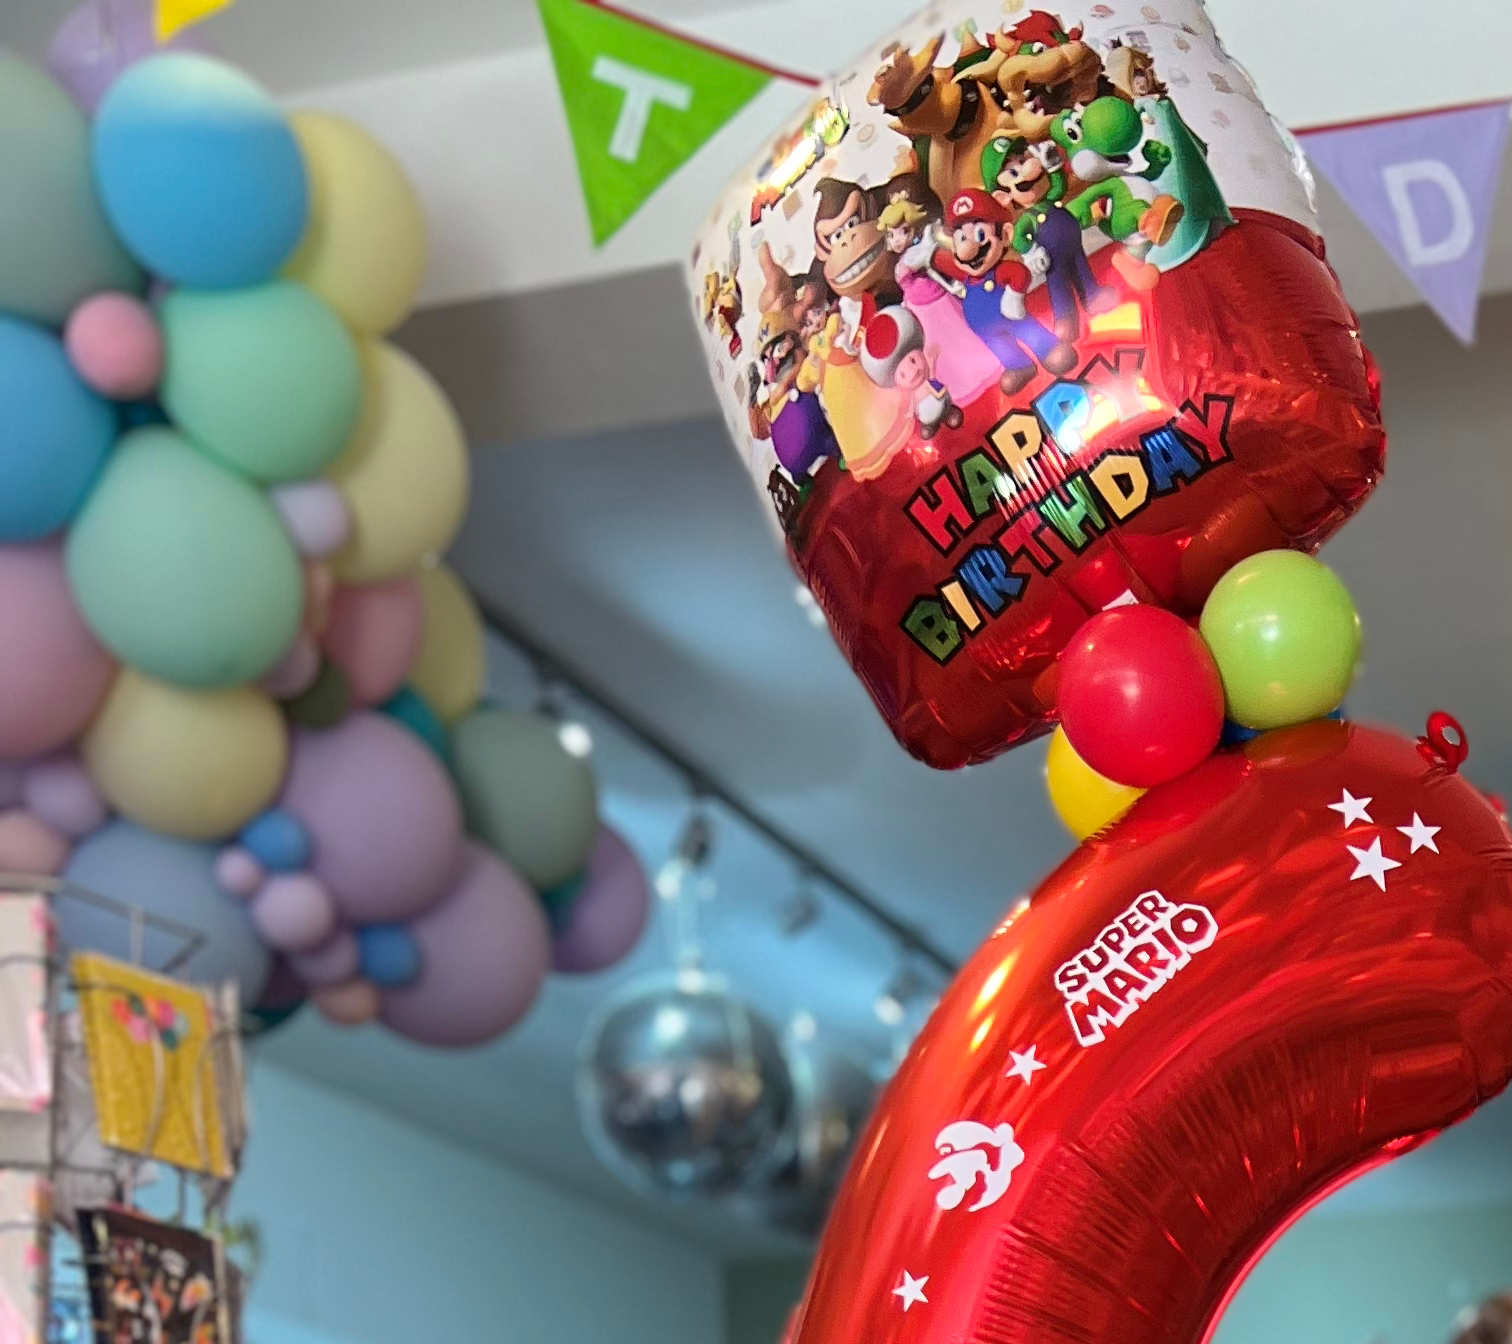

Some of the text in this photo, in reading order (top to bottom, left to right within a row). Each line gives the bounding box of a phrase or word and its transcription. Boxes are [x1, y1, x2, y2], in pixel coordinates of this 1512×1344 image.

[590, 53, 694, 164] T
[1381, 158, 1475, 267] D
[899, 393, 1236, 666] BIRTHDAY
[903, 348, 1145, 558] HAPPY
[1055, 891, 1171, 997] SUPER
[1065, 904, 1218, 1047] MARIO
